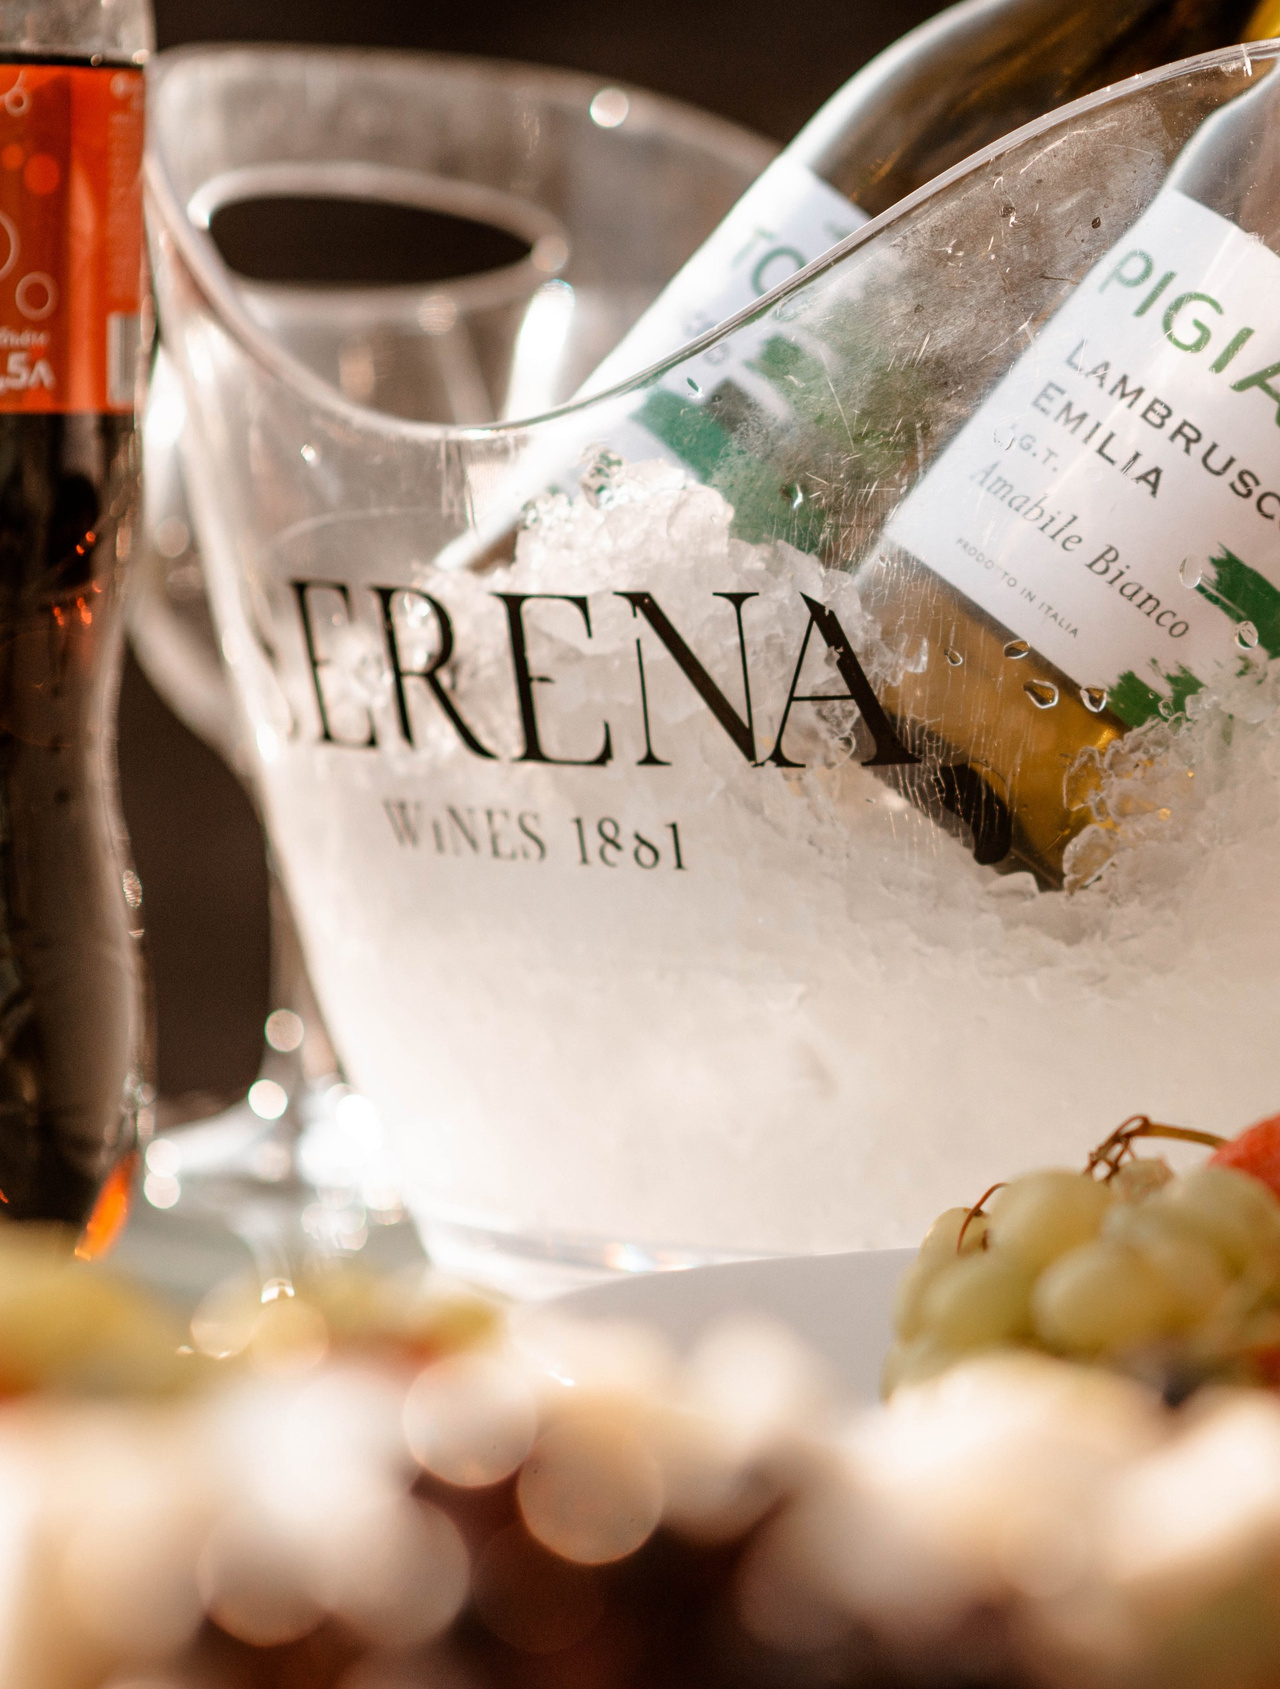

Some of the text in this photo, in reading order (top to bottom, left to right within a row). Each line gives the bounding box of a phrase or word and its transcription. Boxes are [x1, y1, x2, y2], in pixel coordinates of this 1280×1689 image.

[1031, 380, 1164, 499] EMILIA
[955, 537, 1079, 639] PRODOTO IN ITALIA
[969, 460, 1190, 640] Amabile Bianco
